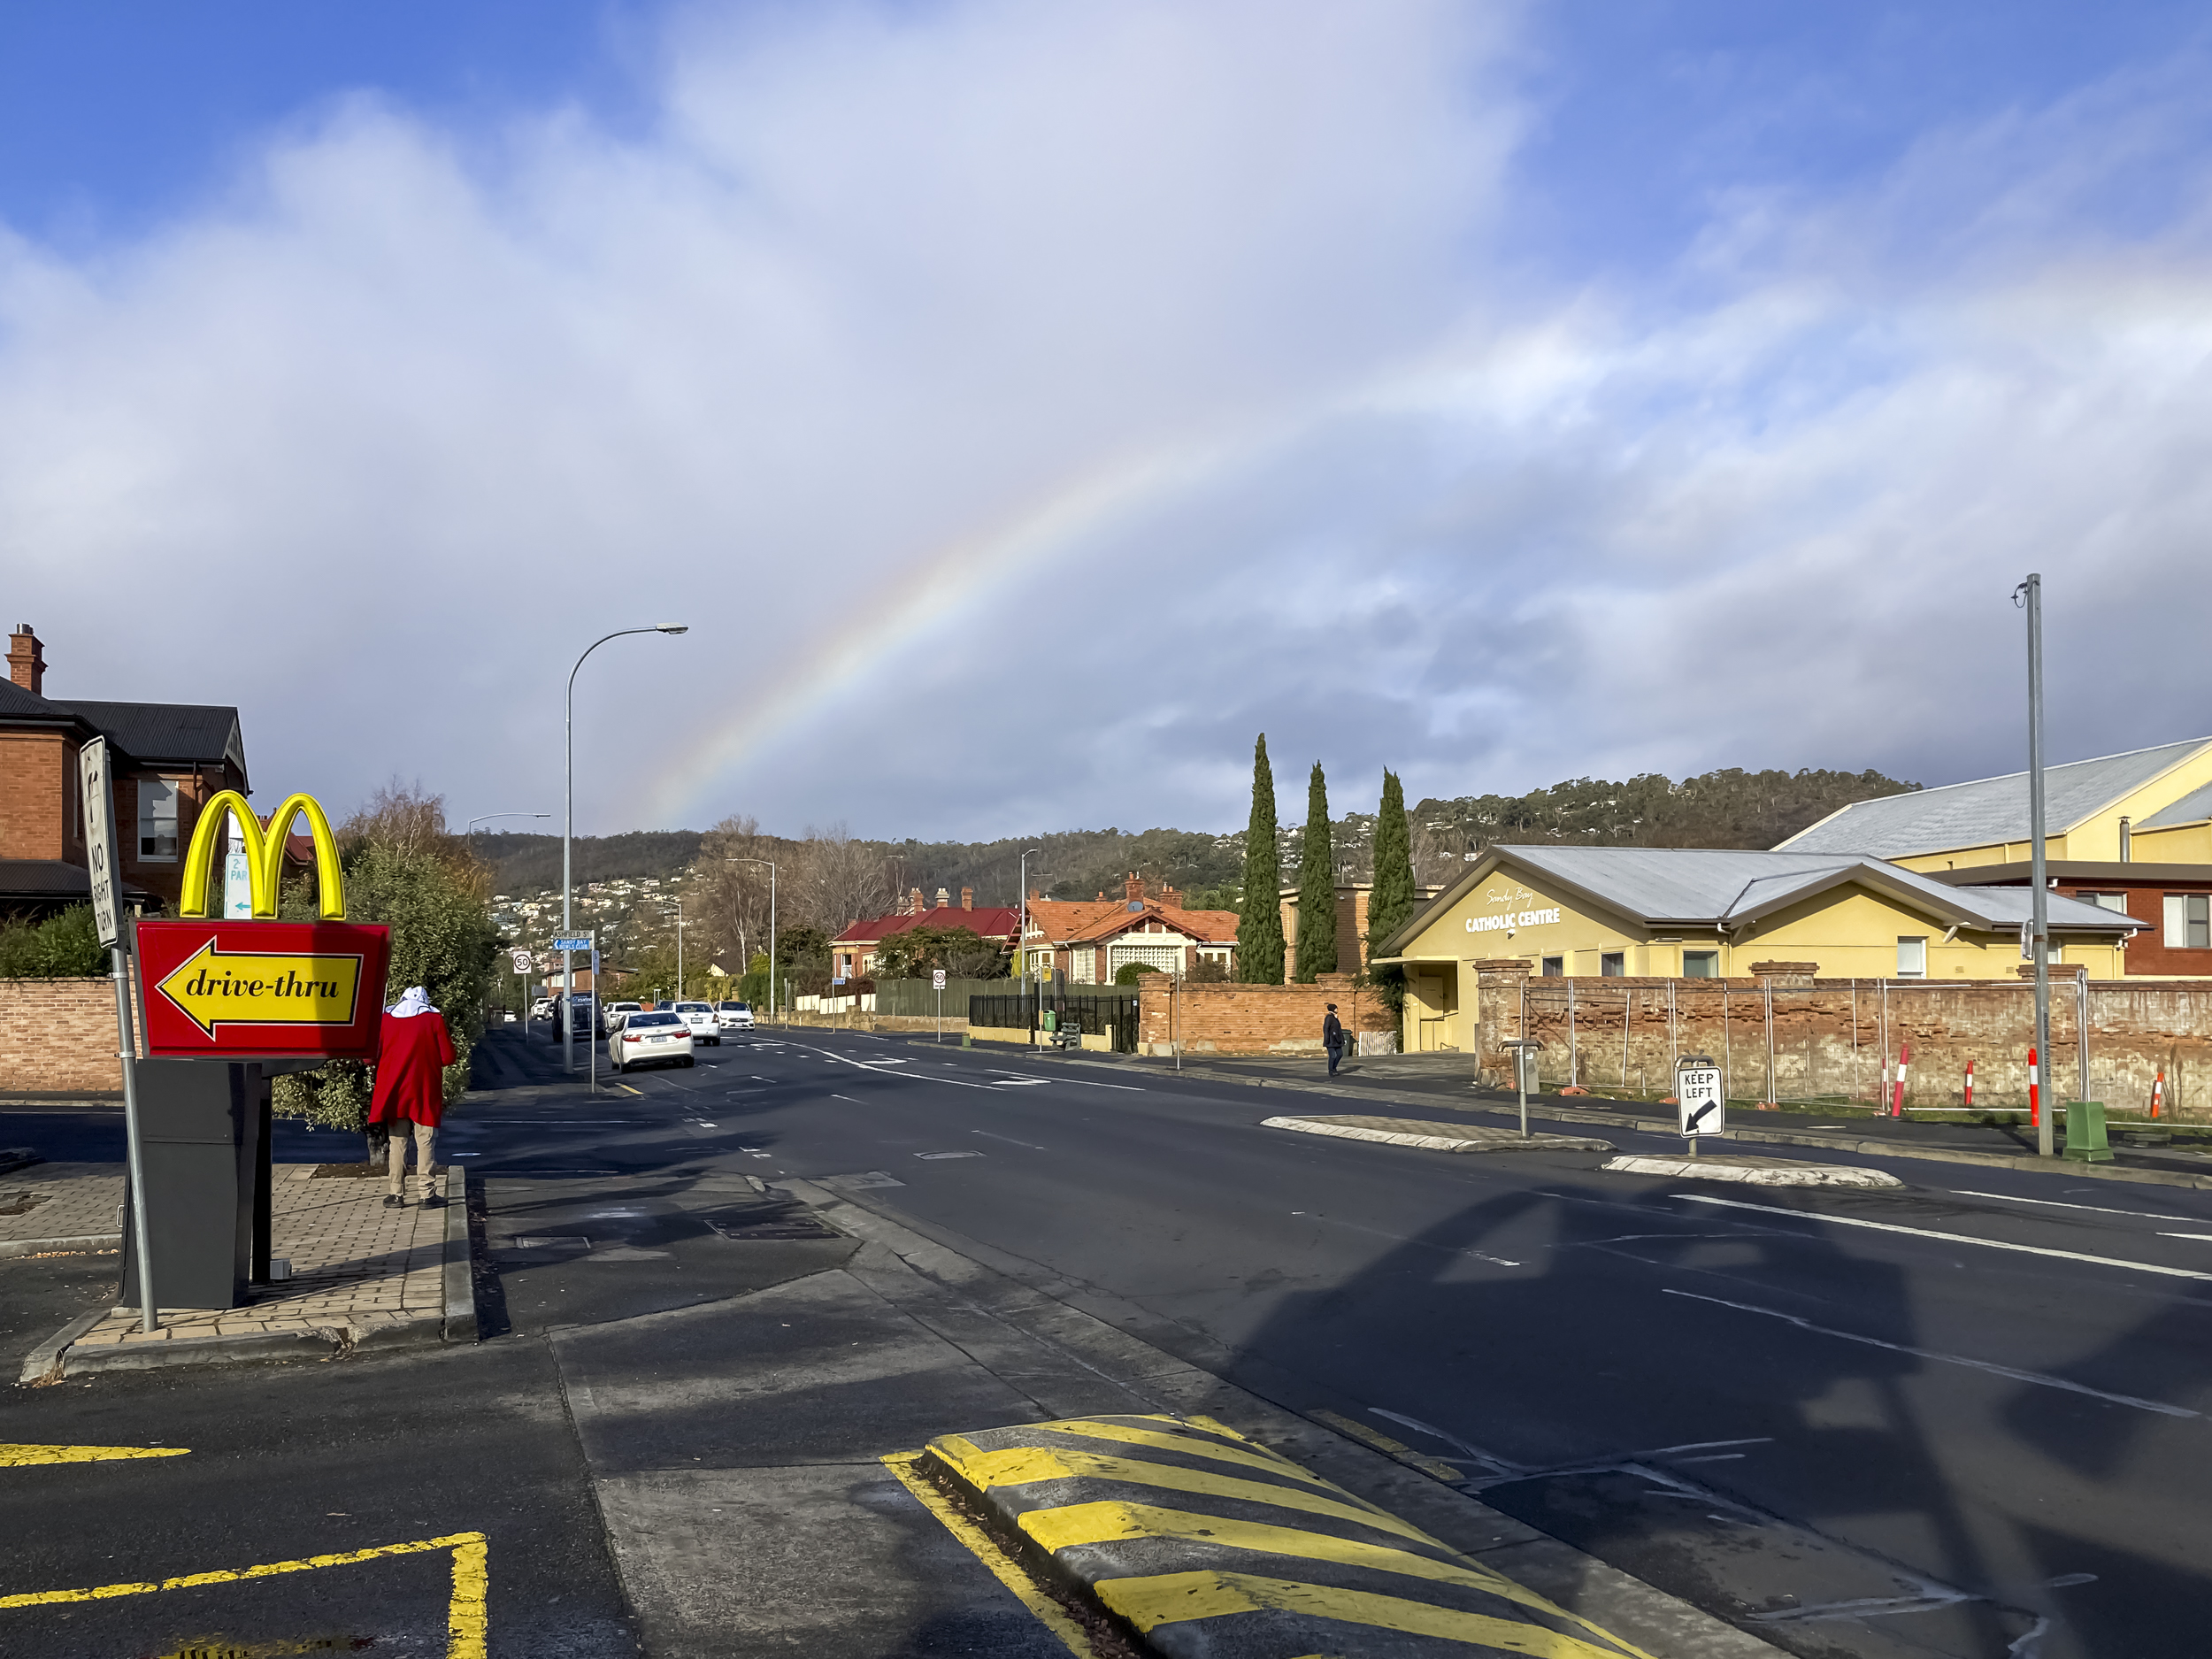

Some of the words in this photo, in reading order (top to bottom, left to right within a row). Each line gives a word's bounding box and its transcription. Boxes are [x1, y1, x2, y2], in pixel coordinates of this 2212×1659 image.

[91, 842, 104, 874] NO
[230, 870, 249, 881] PAR
[93, 879, 109, 903] RIGHT
[1486, 888, 1513, 911] Sandy
[1515, 887, 1533, 909] Bay
[96, 909, 112, 932] TURN
[1465, 912, 1517, 933] CATHOLIC
[1517, 908, 1560, 927] CENTRE
[186, 968, 340, 998] drive-thru
[1685, 1073, 1714, 1085] KEEP
[1686, 1087, 1712, 1098] LEFT
